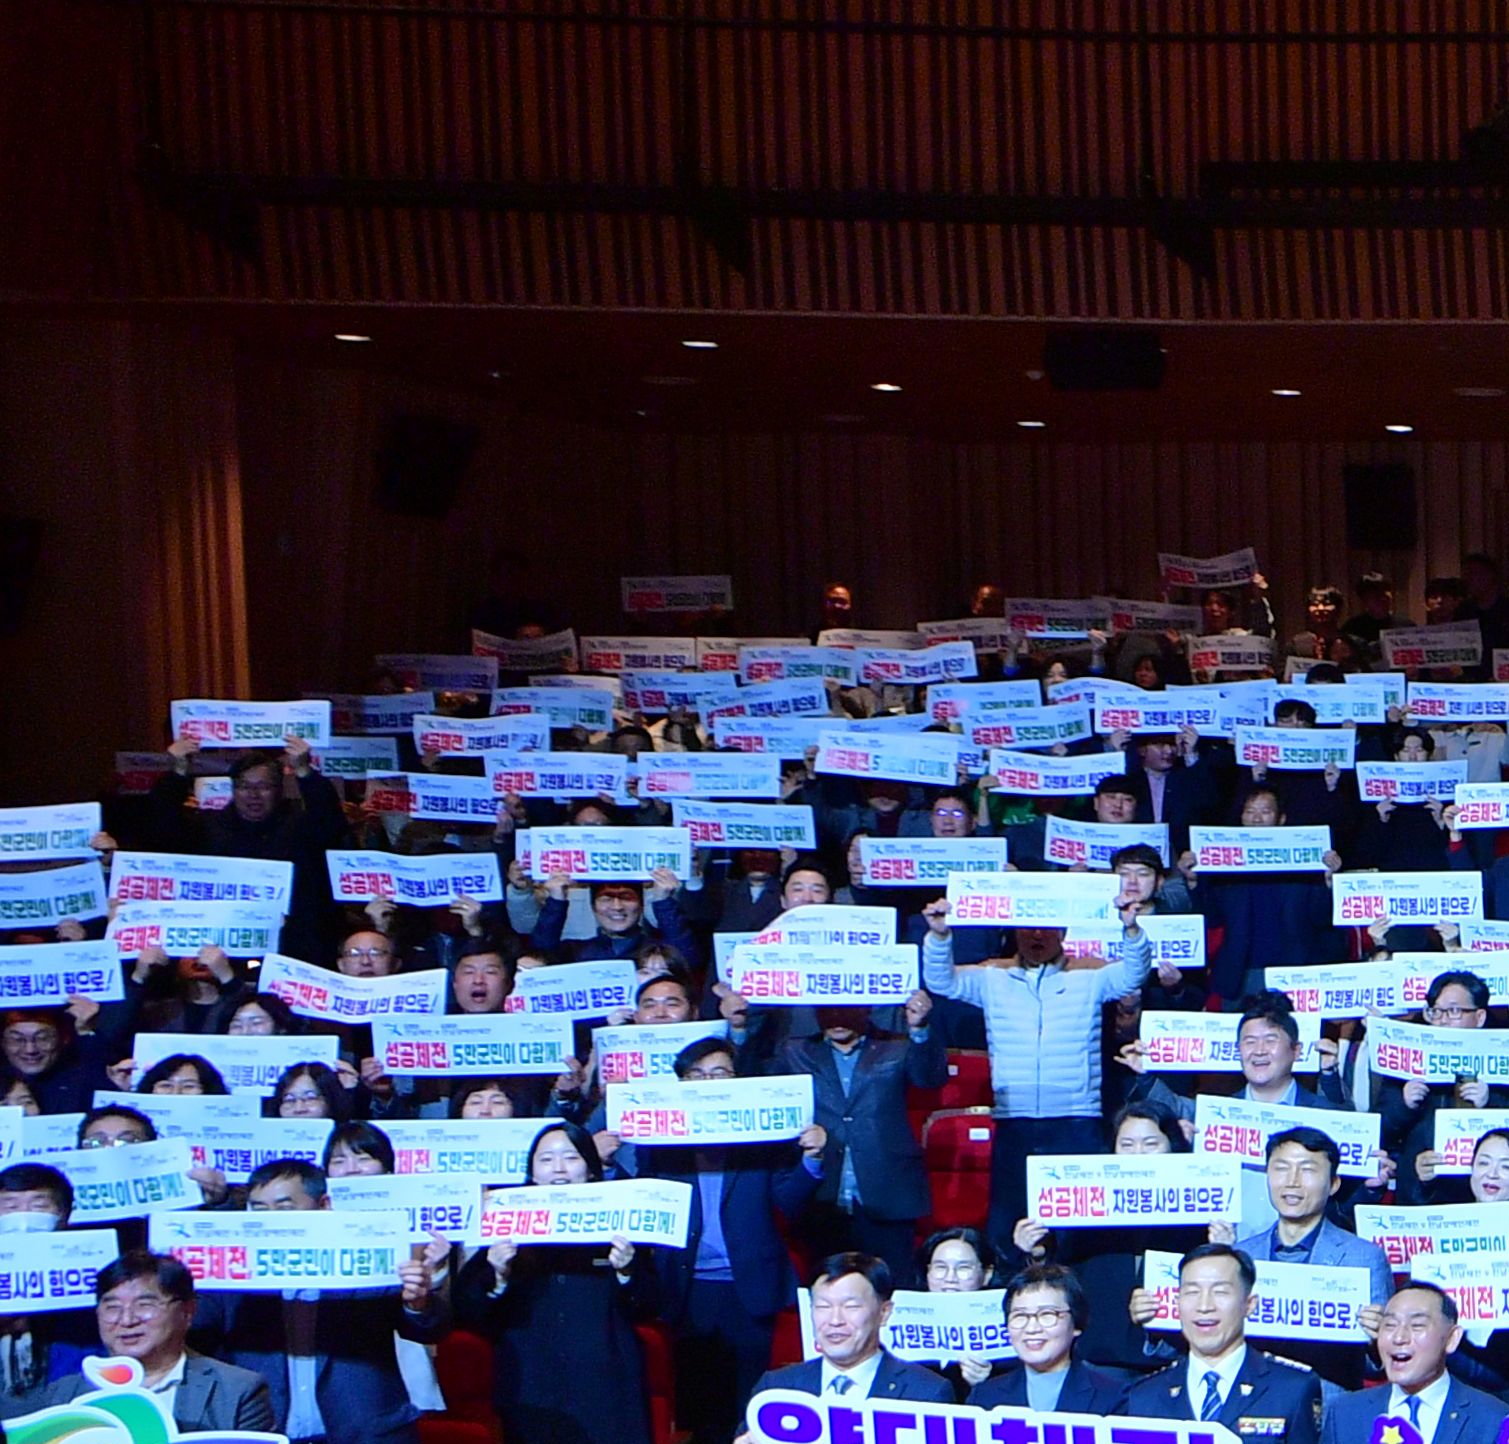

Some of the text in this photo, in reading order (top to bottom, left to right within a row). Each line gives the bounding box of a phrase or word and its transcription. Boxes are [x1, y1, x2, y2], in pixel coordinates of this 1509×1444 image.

[1247, 848, 1294, 864] 5만군민이
[1290, 847, 1323, 863] 다함께!
[1344, 896, 1477, 918] 성공체전, 자원봉사의 힘으로!
[739, 971, 915, 997] 성공체전, 자원봉사의 힘으로!
[331, 996, 390, 1016] 자원봉사의
[393, 994, 436, 1014] 힘으로!
[388, 1042, 561, 1068] 성공체전, 5만군민이 다함께!
[1379, 1045, 1426, 1075] 성공체전,
[1429, 1054, 1484, 1079] 5만군민이
[621, 1110, 689, 1137] 성공체전,
[759, 1107, 802, 1130] 다함께!
[1205, 1126, 1264, 1156] 성공체전,
[1040, 1187, 1232, 1217] 성공체전, 자원봉사의 힘으로!
[421, 1206, 472, 1235] 힘으로!
[482, 1199, 676, 1236] 성공체전, 5만군민이 다함께!
[256, 1248, 394, 1276] 5만군민이 다함께!
[1309, 1300, 1360, 1329] 힘으로!
[889, 1325, 965, 1352] 자원봉사의
